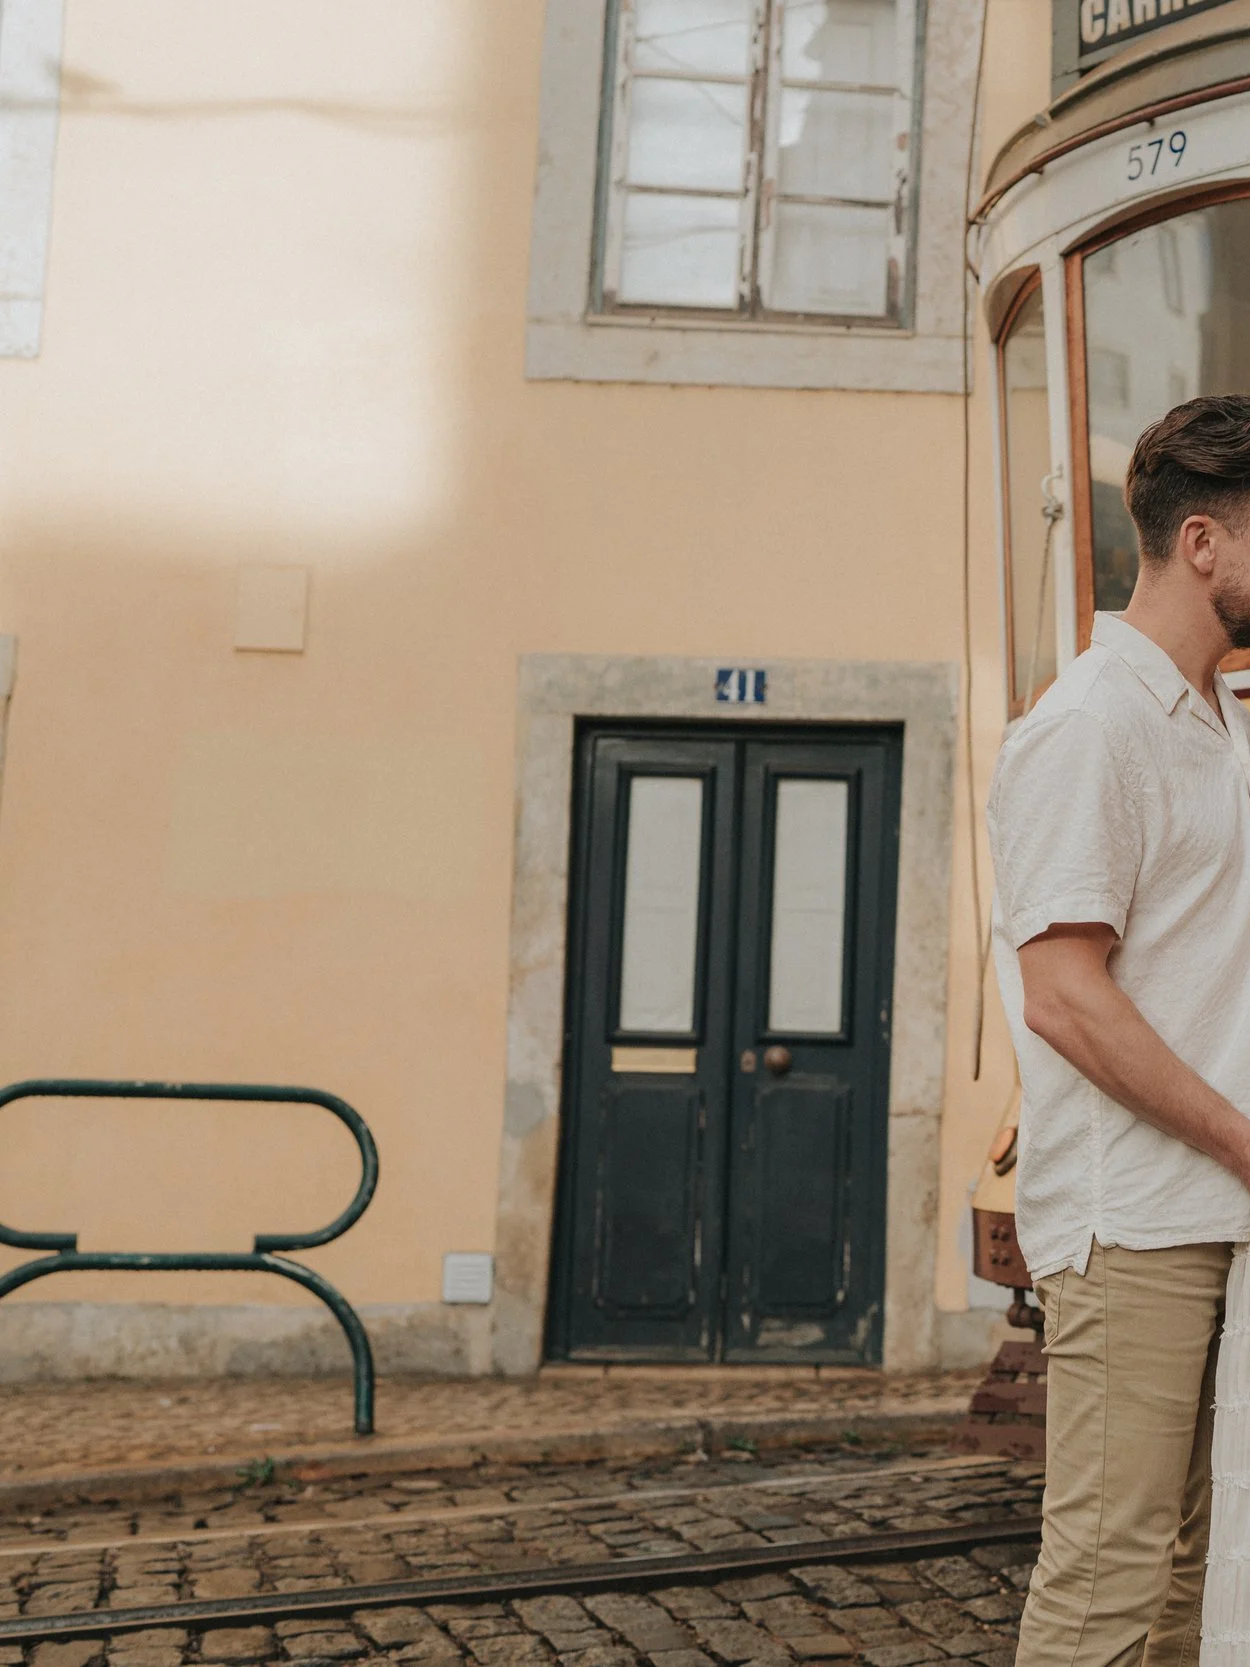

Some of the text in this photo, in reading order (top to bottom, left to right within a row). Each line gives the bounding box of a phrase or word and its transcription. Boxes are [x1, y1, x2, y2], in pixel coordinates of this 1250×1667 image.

[1081, 0, 1204, 43] CAR
[1128, 131, 1187, 181] 579
[717, 668, 757, 703] 41
